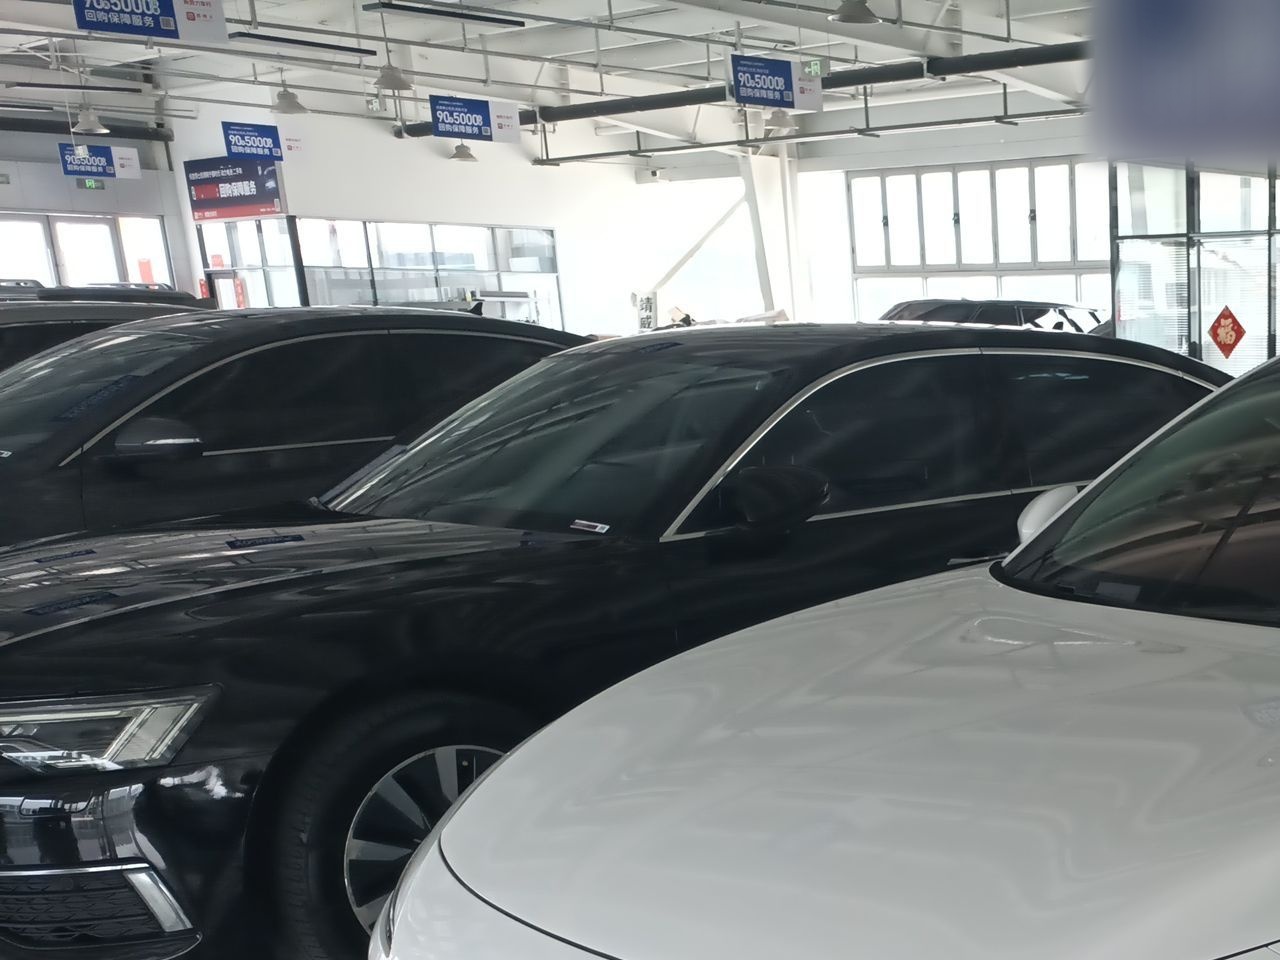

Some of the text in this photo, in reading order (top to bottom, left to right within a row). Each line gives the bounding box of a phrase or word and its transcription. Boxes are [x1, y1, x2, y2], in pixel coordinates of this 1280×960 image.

[85, 9, 154, 28] 回购保障服务
[1217, 318, 1236, 344] 福
